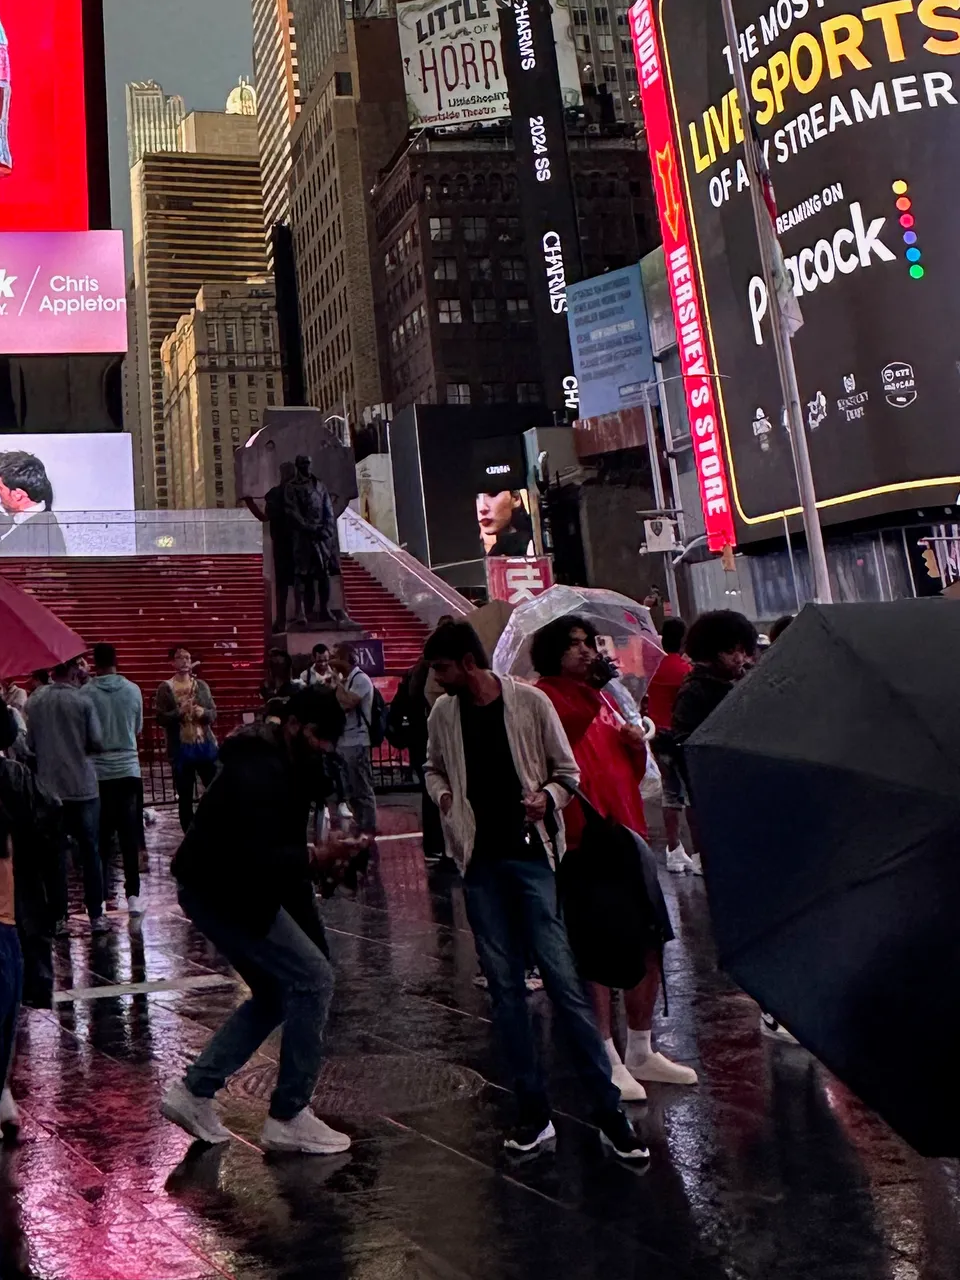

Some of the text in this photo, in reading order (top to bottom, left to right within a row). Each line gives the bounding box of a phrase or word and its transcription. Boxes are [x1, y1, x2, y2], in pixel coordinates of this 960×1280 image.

[419, 39, 507, 112] HORR
[722, 23, 760, 75] THE
[530, 116, 552, 182] 2024 SS
[688, 87, 745, 174] LIVE
[709, 168, 730, 208] OF
[774, 72, 958, 163] STREAMER
[776, 182, 844, 234] REAMING ON
[39, 294, 127, 316] Appleton
[49, 275, 99, 292] Chris
[748, 201, 897, 345] pacock
[670, 245, 728, 517] HERSHEY'S STORE
